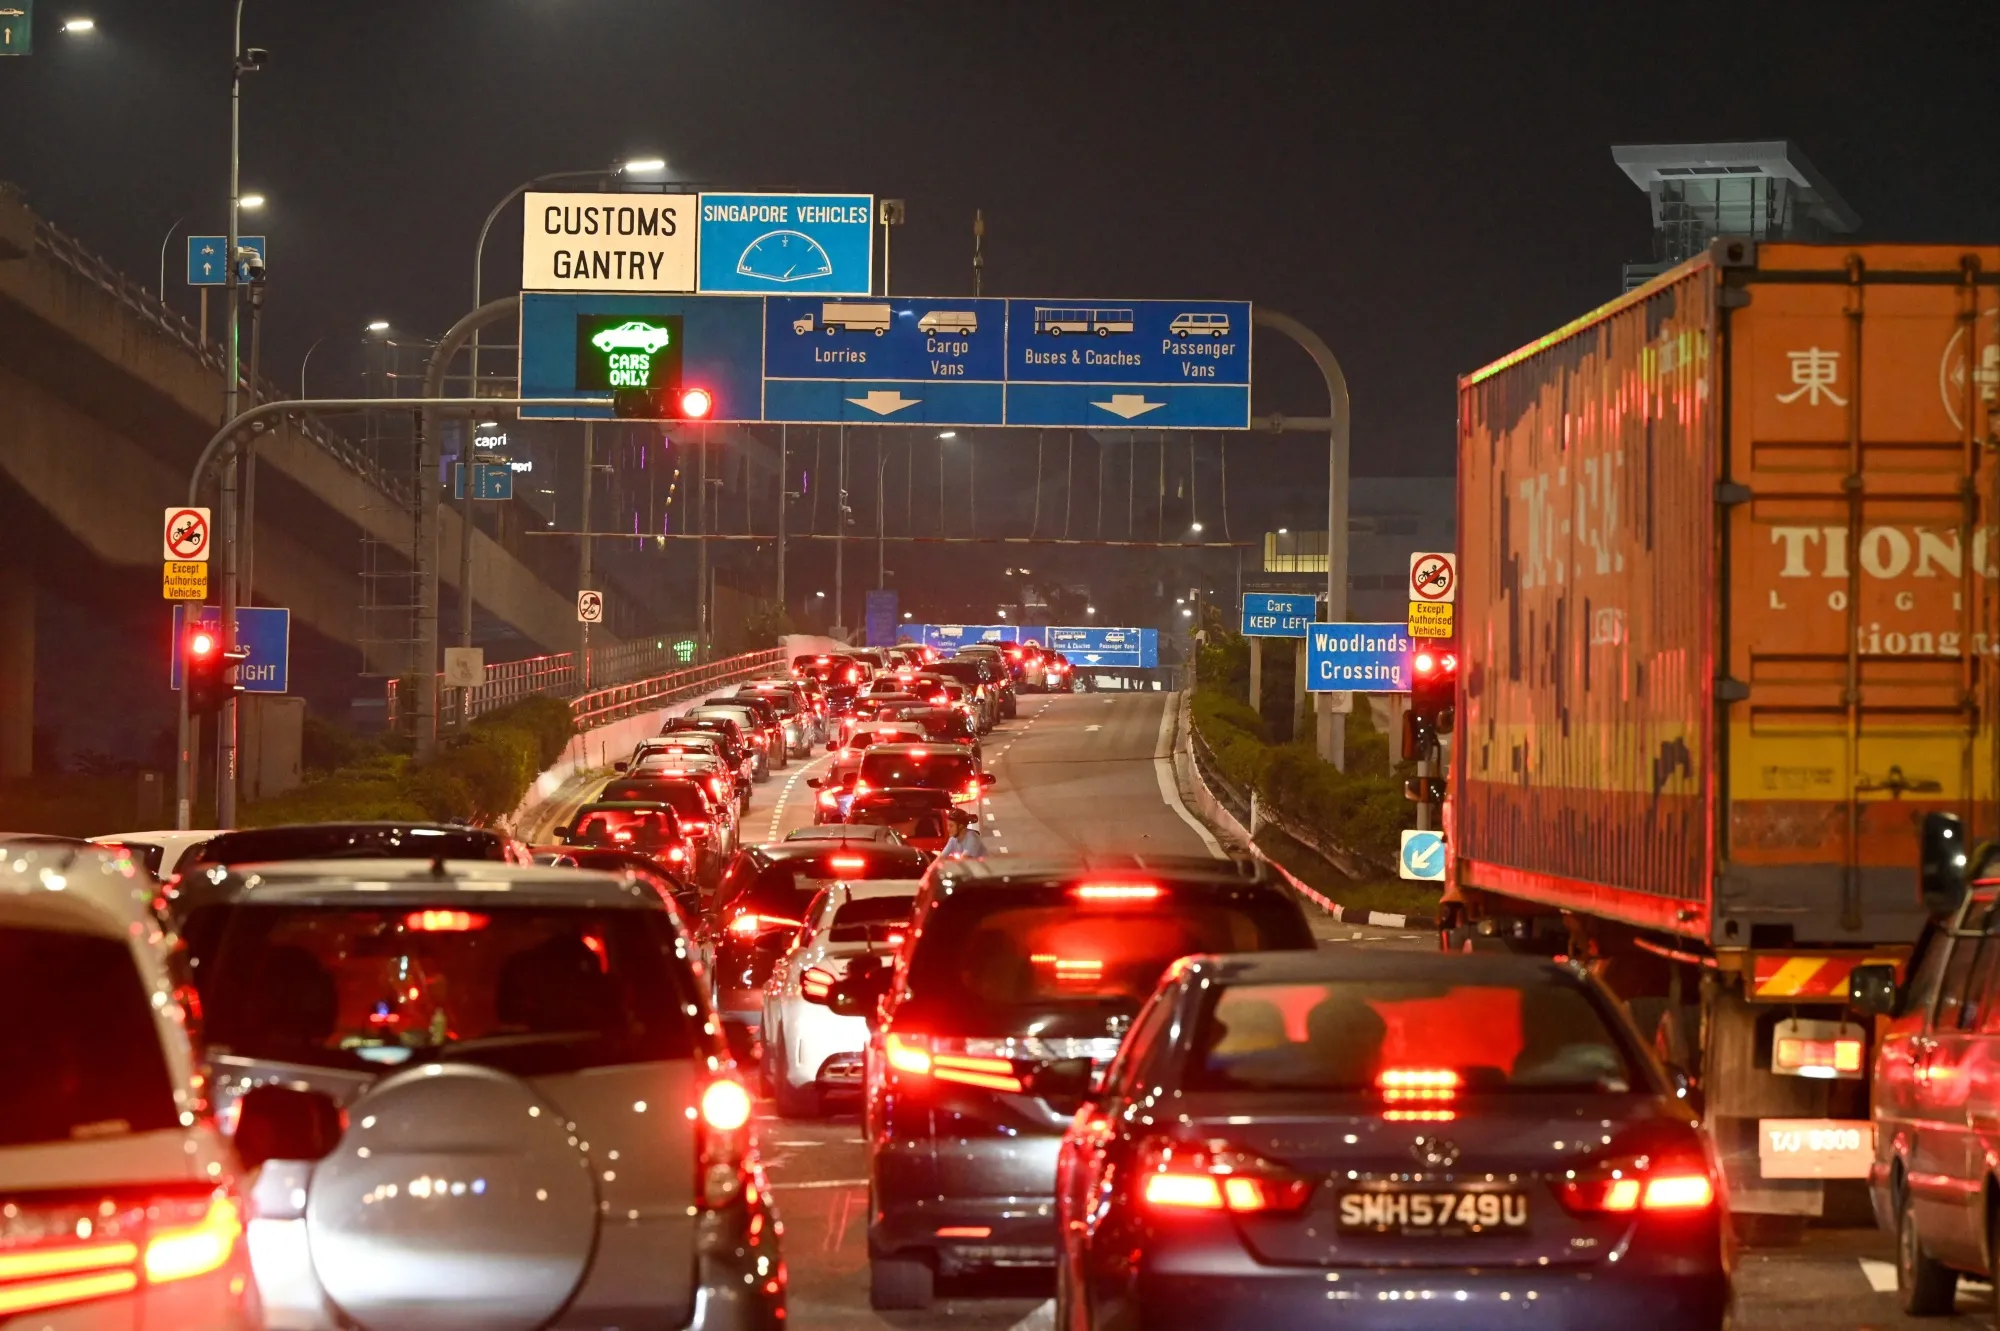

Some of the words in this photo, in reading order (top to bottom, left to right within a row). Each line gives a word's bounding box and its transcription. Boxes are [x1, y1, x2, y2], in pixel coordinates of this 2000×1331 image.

[545, 206, 677, 237] CUSTOMS
[704, 205, 788, 222] SINGAPORE
[797, 206, 868, 224] VEHICLES
[553, 250, 665, 280] GANTRY
[815, 346, 867, 363] Lorries
[926, 338, 969, 357] Cargo
[1162, 340, 1235, 359] Passenger
[609, 354, 650, 370] CARS
[1025, 349, 1066, 365] Buses
[1072, 350, 1081, 365] &
[1085, 350, 1141, 366] Coaches
[931, 360, 964, 376] Vans
[1182, 362, 1215, 378] Vans
[609, 370, 649, 387] ONLY
[1775, 347, 1849, 406] 東
[475, 433, 507, 448] capri
[172, 563, 199, 574] Except
[164, 575, 207, 586] Authorised
[169, 587, 201, 598] Vehicles
[1267, 599, 1292, 612] Cars
[1417, 604, 1445, 615] Except
[1250, 616, 1277, 629] KEEP
[1282, 617, 1307, 629] LEFT
[1409, 614, 1452, 626] Authorised
[1414, 625, 1446, 636] Vehicles
[1315, 634, 1407, 653] Woodlands
[1320, 661, 1401, 684] Crossing
[1340, 1194, 1527, 1226] SMH5749U
